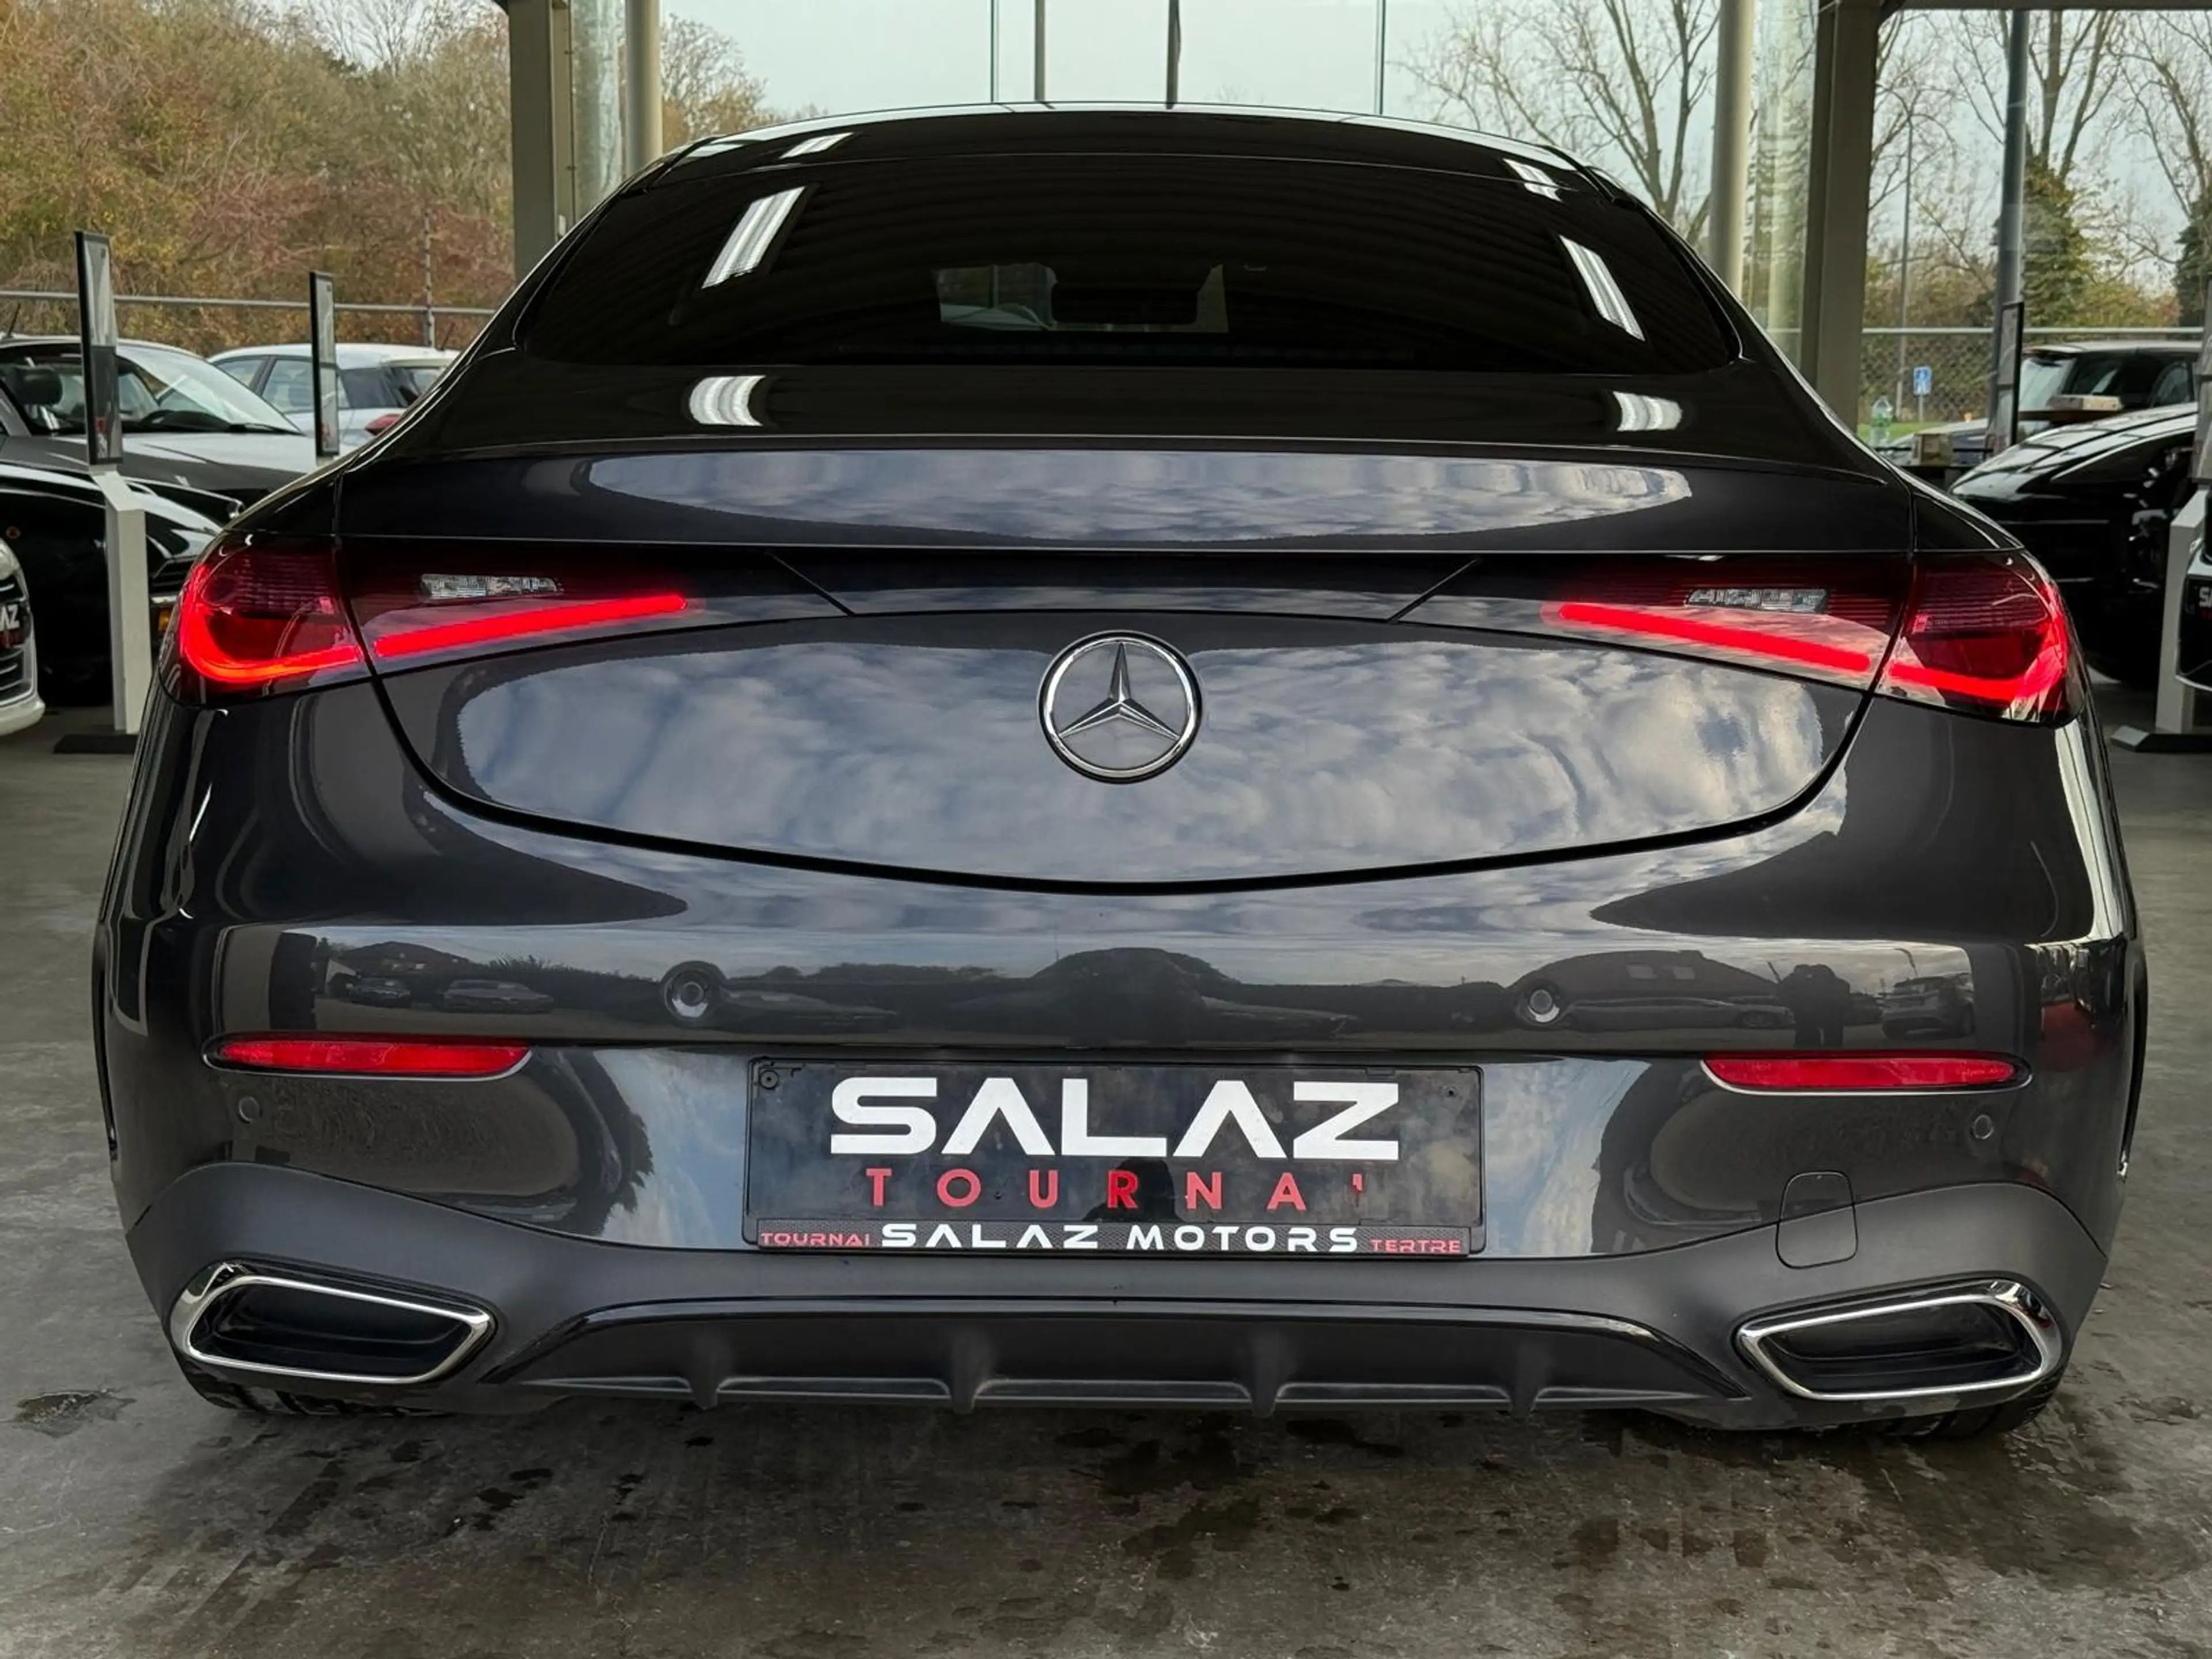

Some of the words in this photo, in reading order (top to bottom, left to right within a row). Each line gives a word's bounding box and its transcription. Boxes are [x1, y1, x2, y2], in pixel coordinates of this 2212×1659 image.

[830, 1077, 1399, 1161] SALAZ
[760, 1232, 870, 1247] TOURNAI
[881, 1223, 1099, 1249] SALAZ
[1126, 1225, 1358, 1253] MOTORS
[1371, 1239, 1461, 1253] TERTRE
